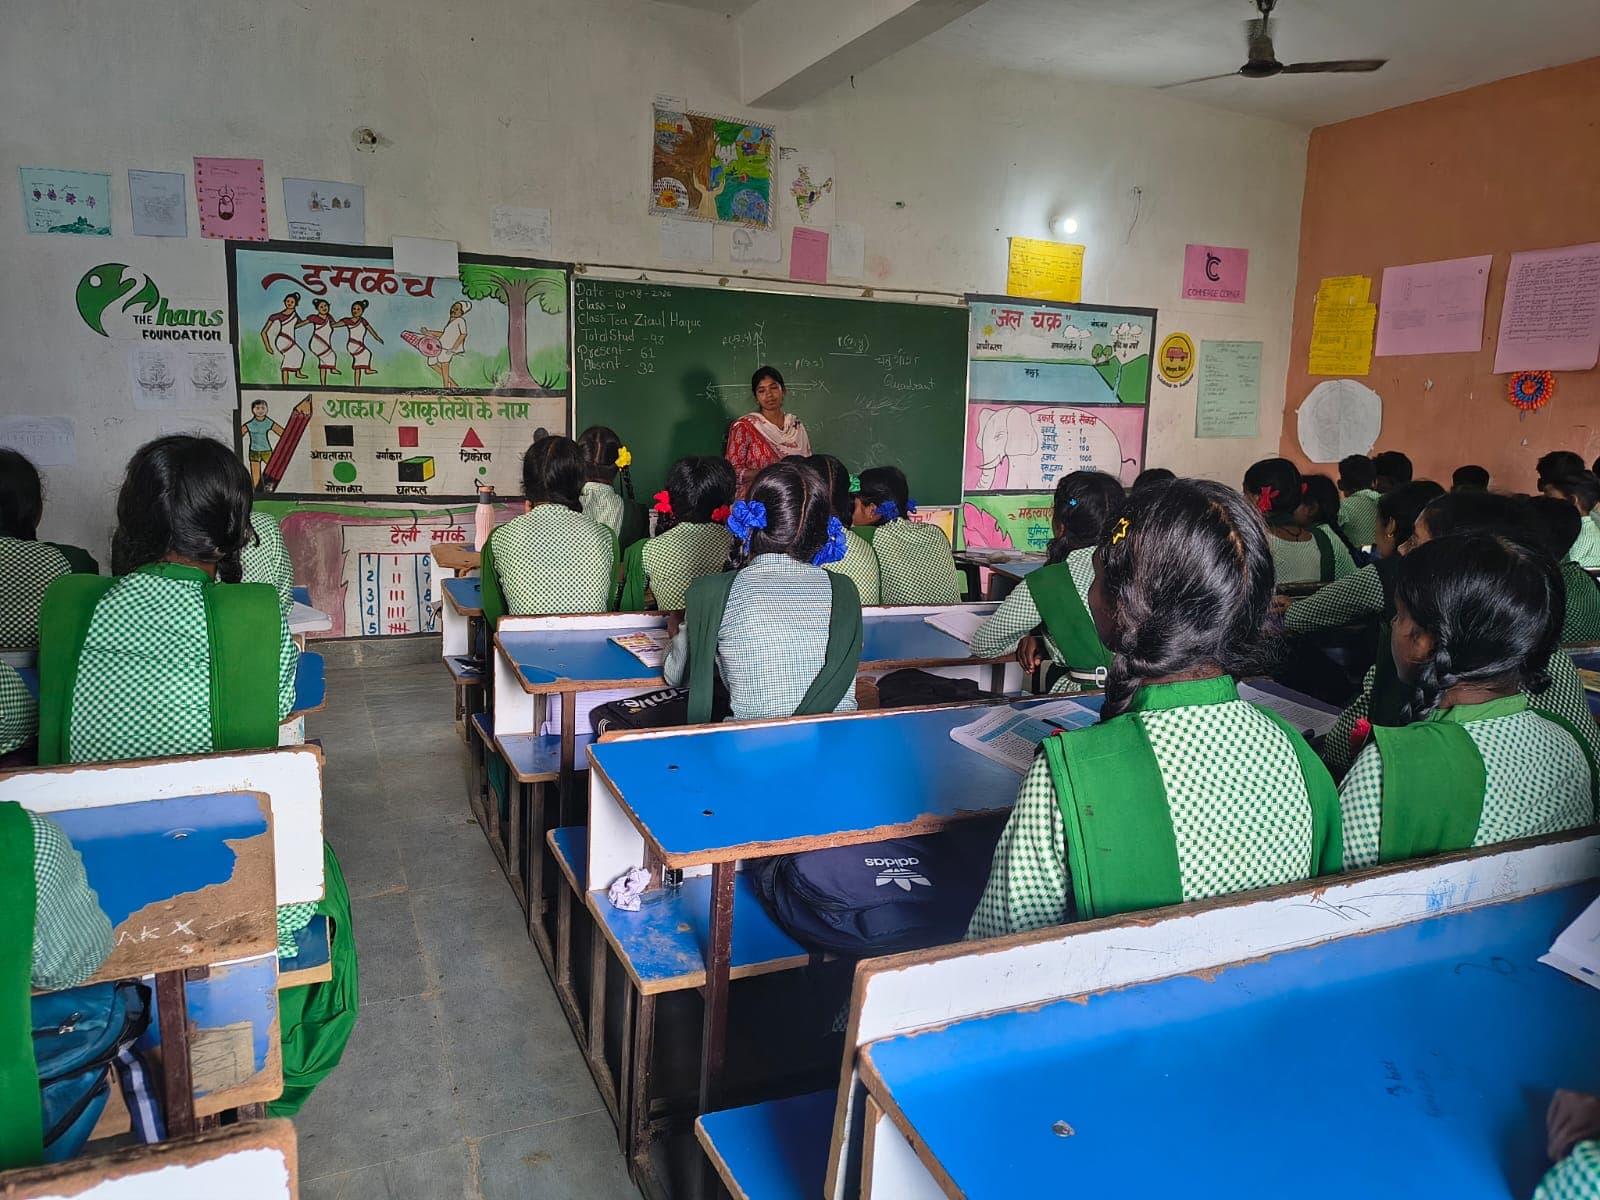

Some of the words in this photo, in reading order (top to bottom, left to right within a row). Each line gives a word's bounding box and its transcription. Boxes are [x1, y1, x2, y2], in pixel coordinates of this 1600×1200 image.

[133, 315, 153, 325] THE
[577, 312, 606, 326] Class
[477, 397, 493, 420] के
[497, 402, 531, 420] नाम
[430, 526, 466, 542] मार्क
[422, 555, 431, 567] 6
[367, 570, 374, 582] 2
[424, 572, 432, 584] 7
[366, 587, 375, 603] 3
[424, 588, 432, 601] 8
[367, 604, 374, 618] 4
[367, 622, 377, 634] 5
[864, 857, 920, 868] adidas
